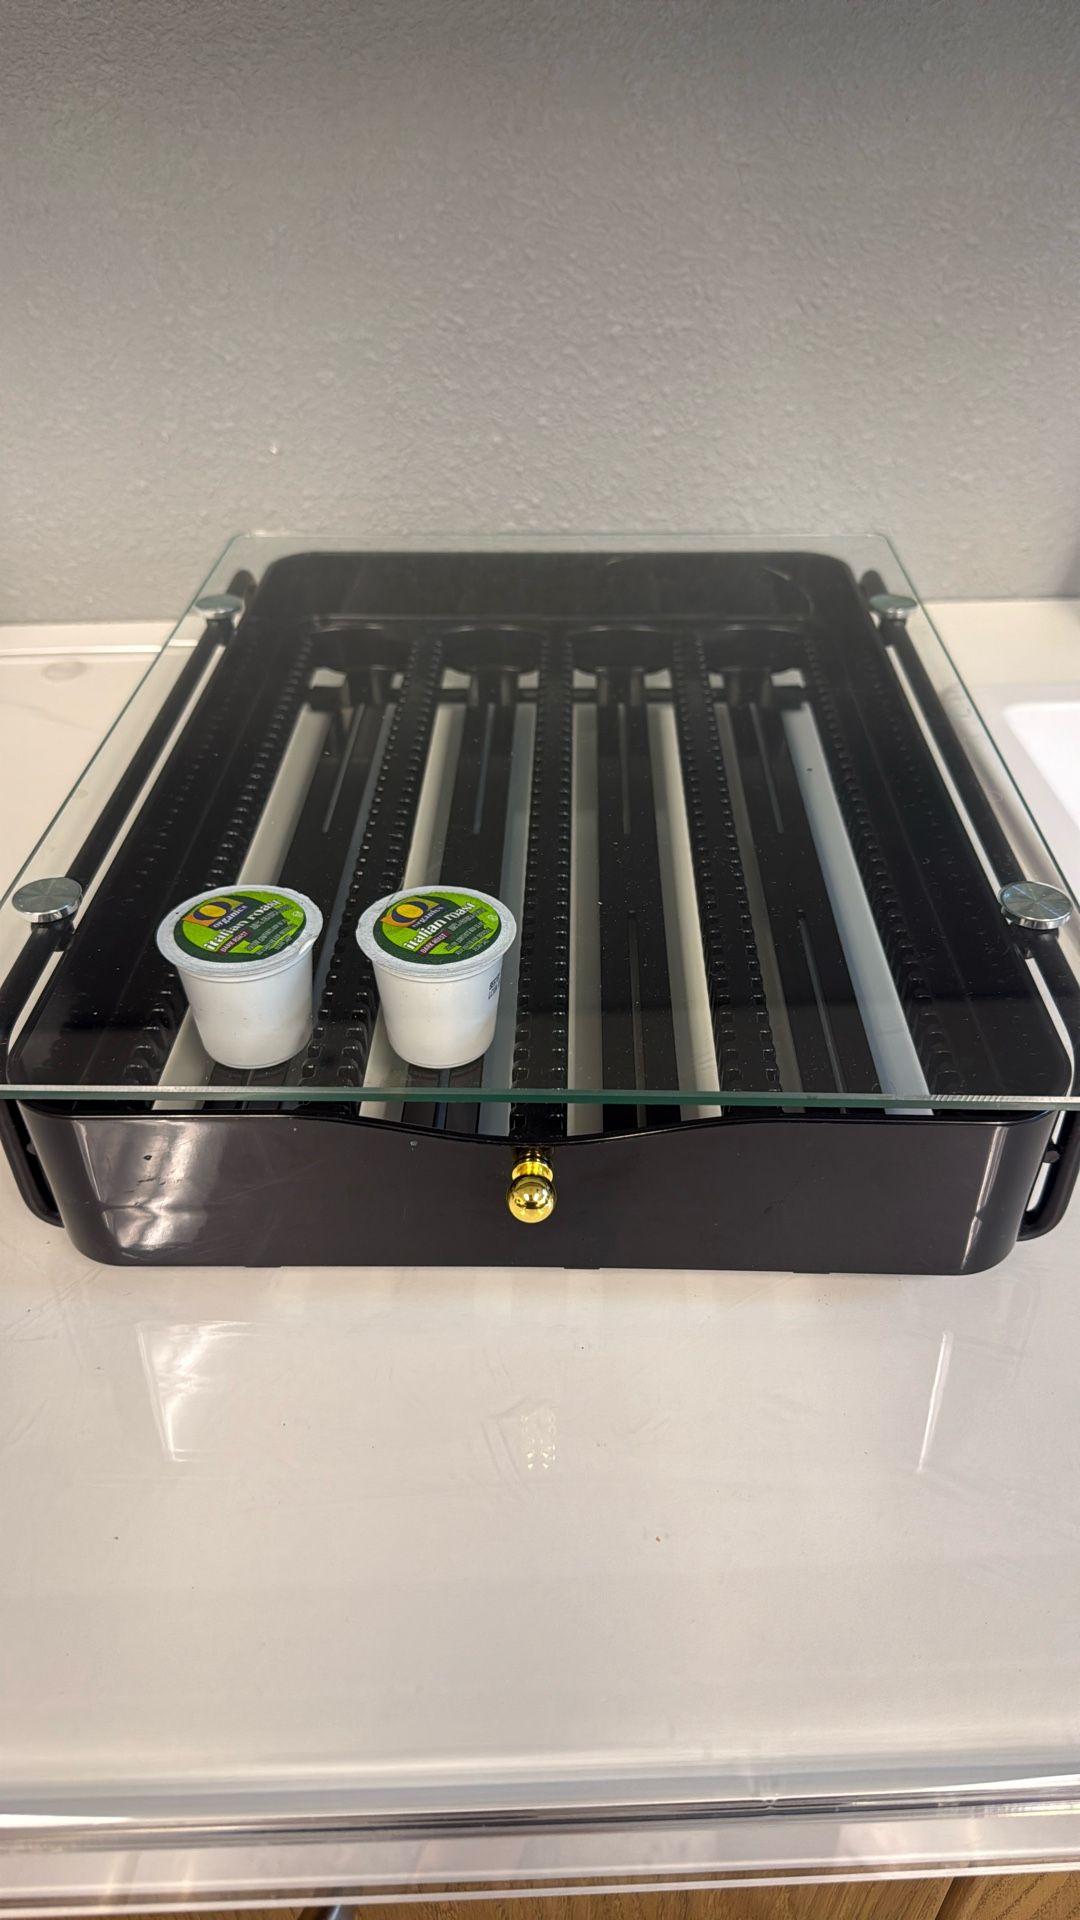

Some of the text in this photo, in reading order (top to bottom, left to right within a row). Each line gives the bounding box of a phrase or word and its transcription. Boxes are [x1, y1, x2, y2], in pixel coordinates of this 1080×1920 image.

[204, 918, 249, 950] italian
[248, 899, 281, 924] roast
[213, 905, 249, 928] organics
[403, 918, 444, 949] italian
[444, 902, 475, 922] roast
[411, 906, 444, 927] organics
[221, 938, 235, 953] DARK
[420, 940, 433, 954] DARK
